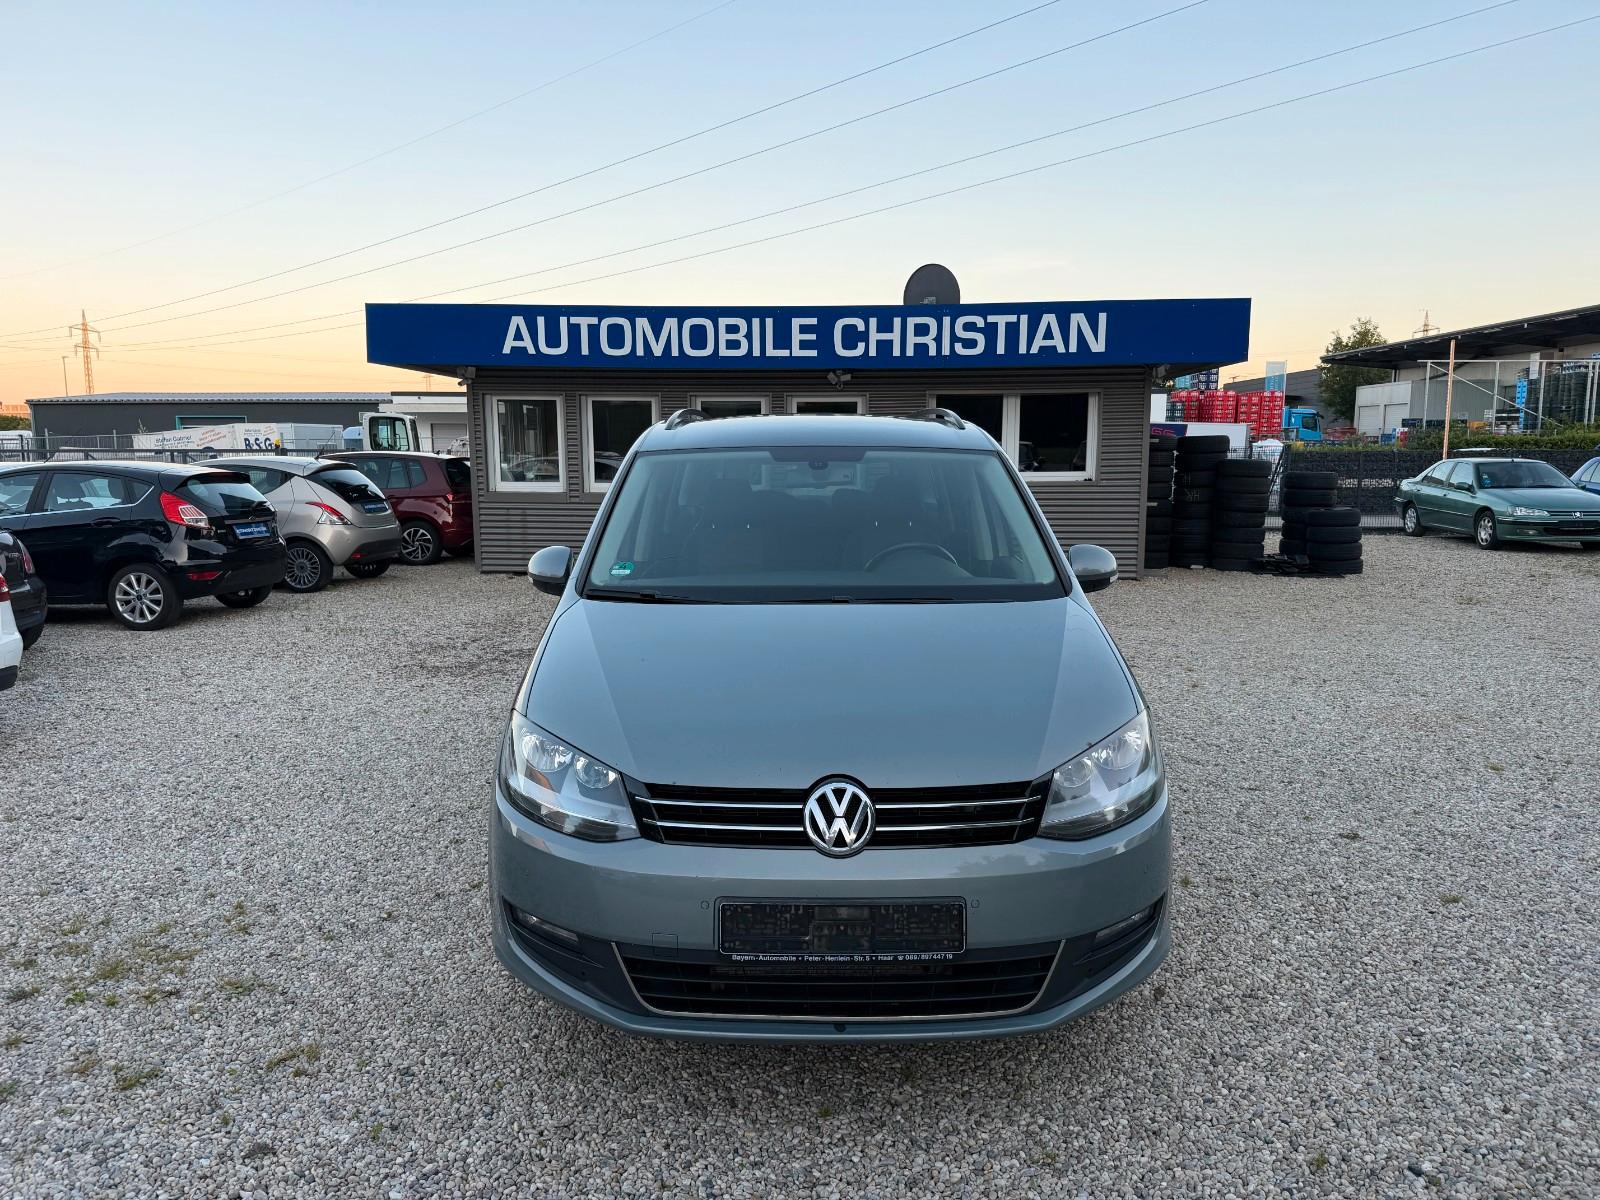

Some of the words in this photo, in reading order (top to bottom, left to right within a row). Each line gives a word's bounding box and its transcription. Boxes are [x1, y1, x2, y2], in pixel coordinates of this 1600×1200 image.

[502, 314, 818, 358] AUTOMOBILE
[833, 312, 1108, 358] CHRISTIAN
[805, 782, 872, 852] VW
